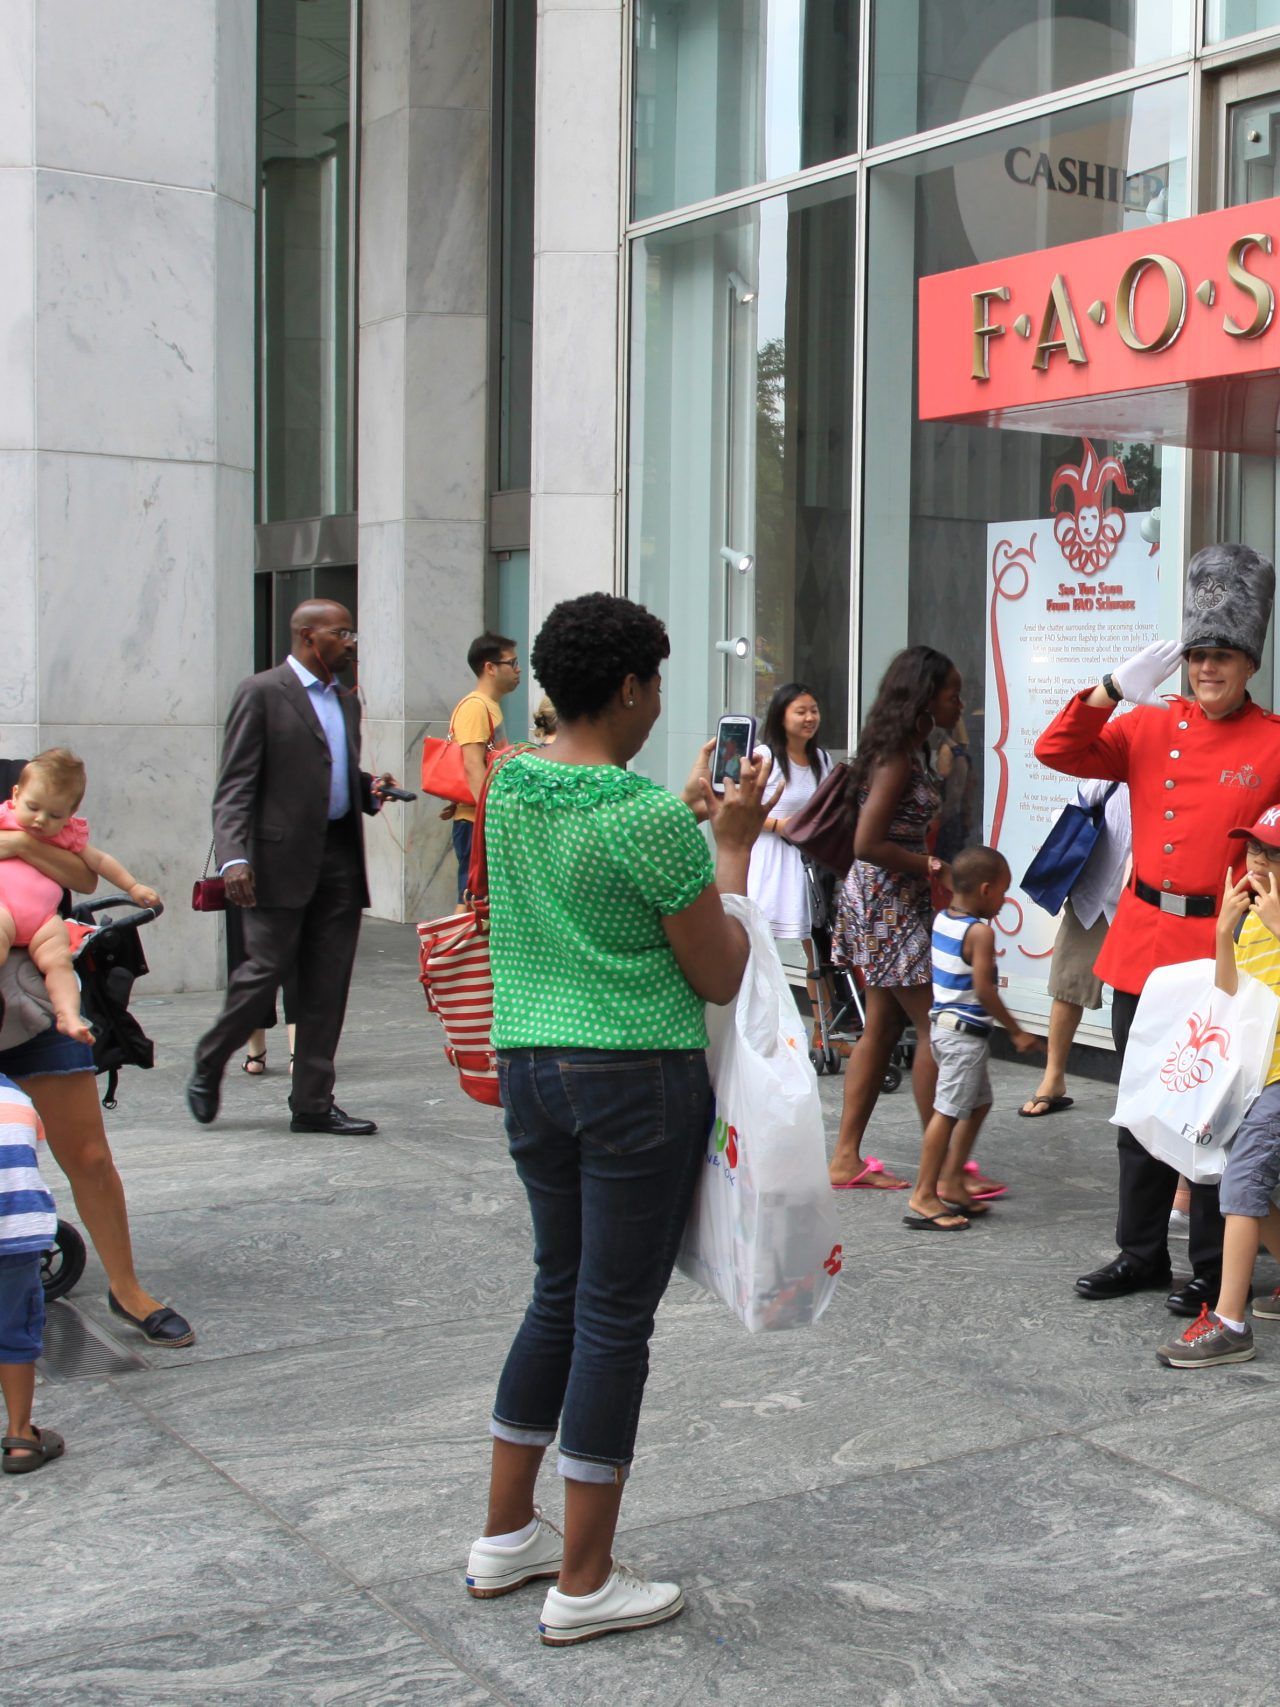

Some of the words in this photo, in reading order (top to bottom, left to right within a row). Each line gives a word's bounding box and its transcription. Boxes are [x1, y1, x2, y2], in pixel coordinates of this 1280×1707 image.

[1058, 583, 1076, 596] See
[1078, 582, 1096, 595] You
[1098, 581, 1123, 595] Soon
[1046, 599, 1070, 611] From
[1073, 598, 1094, 611] FAO
[1096, 596, 1136, 610] Schwarz
[1066, 622, 1096, 632] surrounding
[1107, 623, 1133, 633] upcoming
[1134, 620, 1154, 631] closure
[1056, 632, 1078, 642] Schwarz
[1078, 632, 1099, 644] flagship
[1130, 632, 1141, 644] July
[1112, 643, 1121, 652] the
[1081, 655, 1100, 664] created
[1101, 654, 1119, 664] within
[1220, 769, 1262, 789] FAO
[1180, 1122, 1213, 1146] FAO
